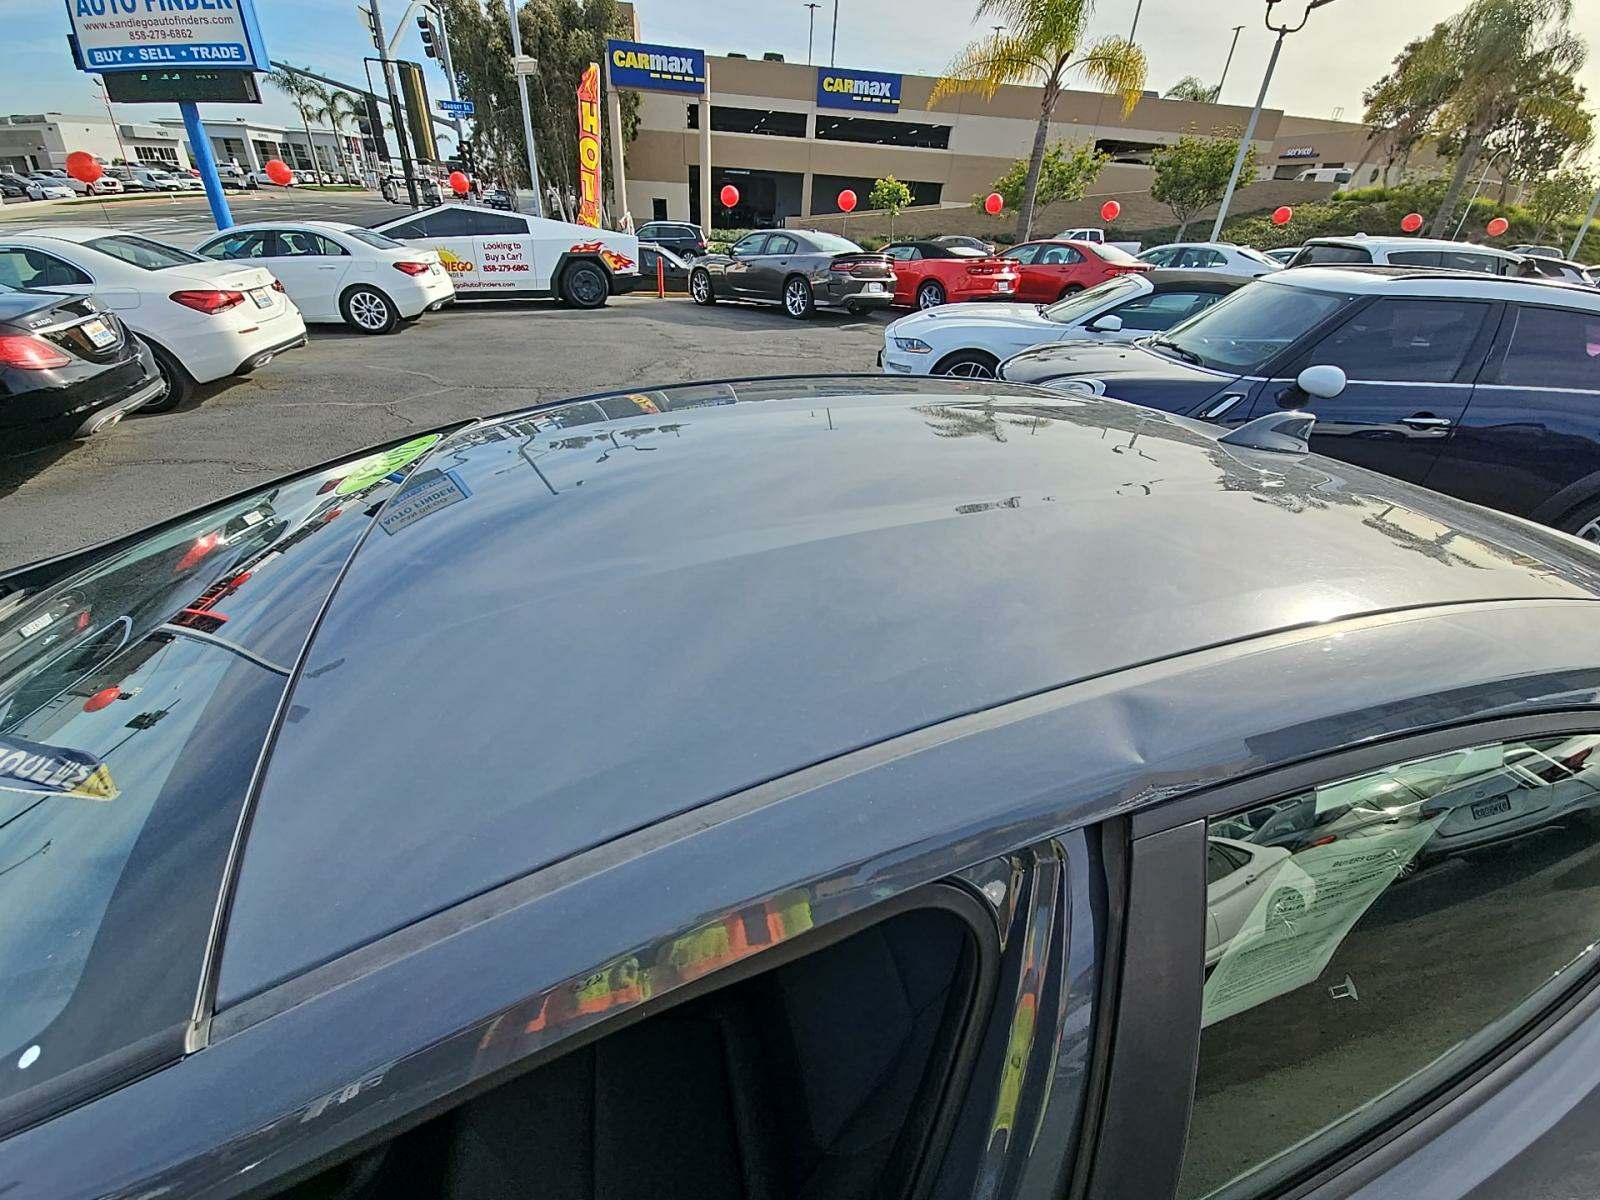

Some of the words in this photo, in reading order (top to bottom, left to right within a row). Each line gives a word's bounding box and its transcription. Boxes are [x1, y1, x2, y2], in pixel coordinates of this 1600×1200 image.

[84, 15, 233, 31] www.sandiegoautofinders.com
[129, 29, 194, 41] 858-279-6862
[95, 50, 122, 63] BUY
[140, 47, 176, 61] SELL
[190, 46, 241, 59] TRADE
[580, 101, 599, 202] HOT
[483, 242, 512, 252] Looking
[514, 242, 521, 250] to
[485, 253, 499, 262] Buy
[506, 252, 522, 261] Car?
